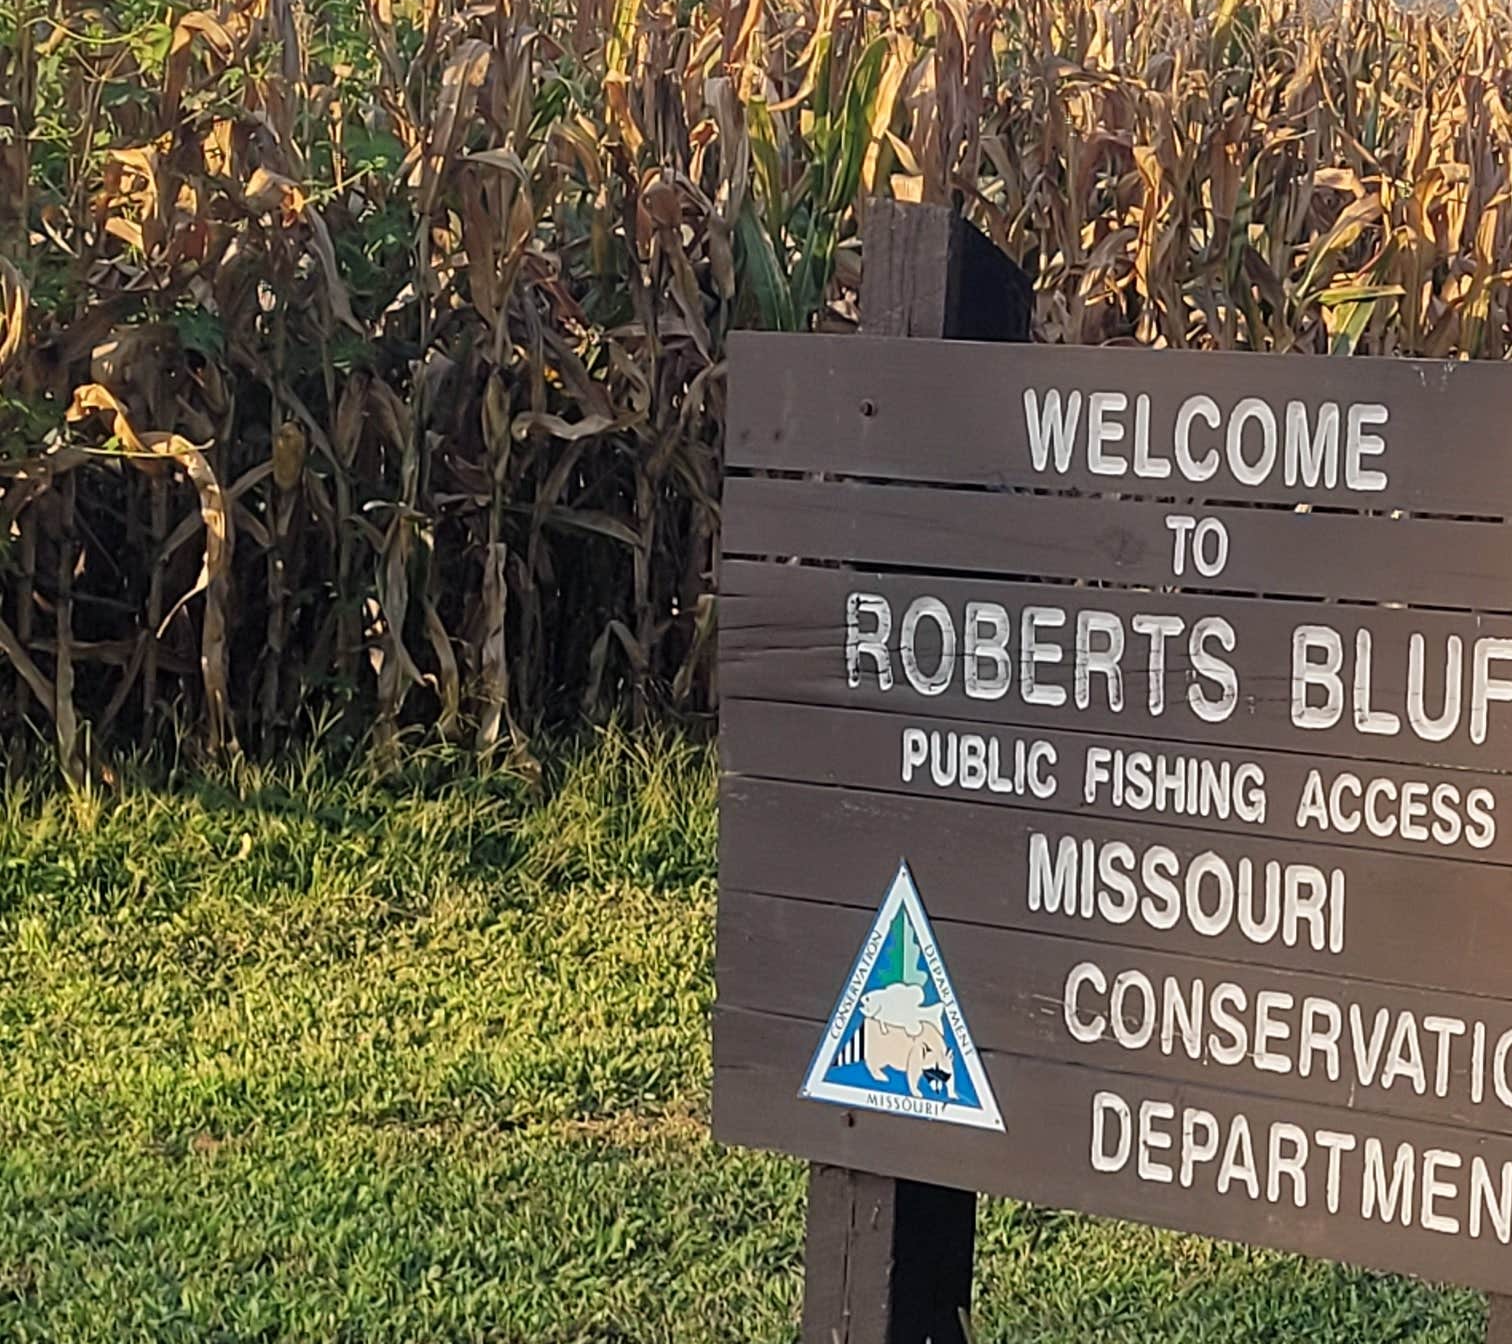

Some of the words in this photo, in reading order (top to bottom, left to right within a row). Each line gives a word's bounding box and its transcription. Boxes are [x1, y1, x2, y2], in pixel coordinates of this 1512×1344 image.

[1023, 388, 1390, 492] WELCOME
[1165, 514, 1229, 578] TO
[844, 592, 1238, 723] ROBERTS
[900, 727, 1057, 800] PUBLIC
[1083, 746, 1266, 824] FISHING
[1296, 769, 1497, 849] ACCESS
[1027, 834, 1346, 954] MISSOURI
[830, 930, 883, 1041] CONSERVATION
[922, 943, 974, 1057] DEPARTMENT
[866, 1092, 940, 1117] MISSOURI
